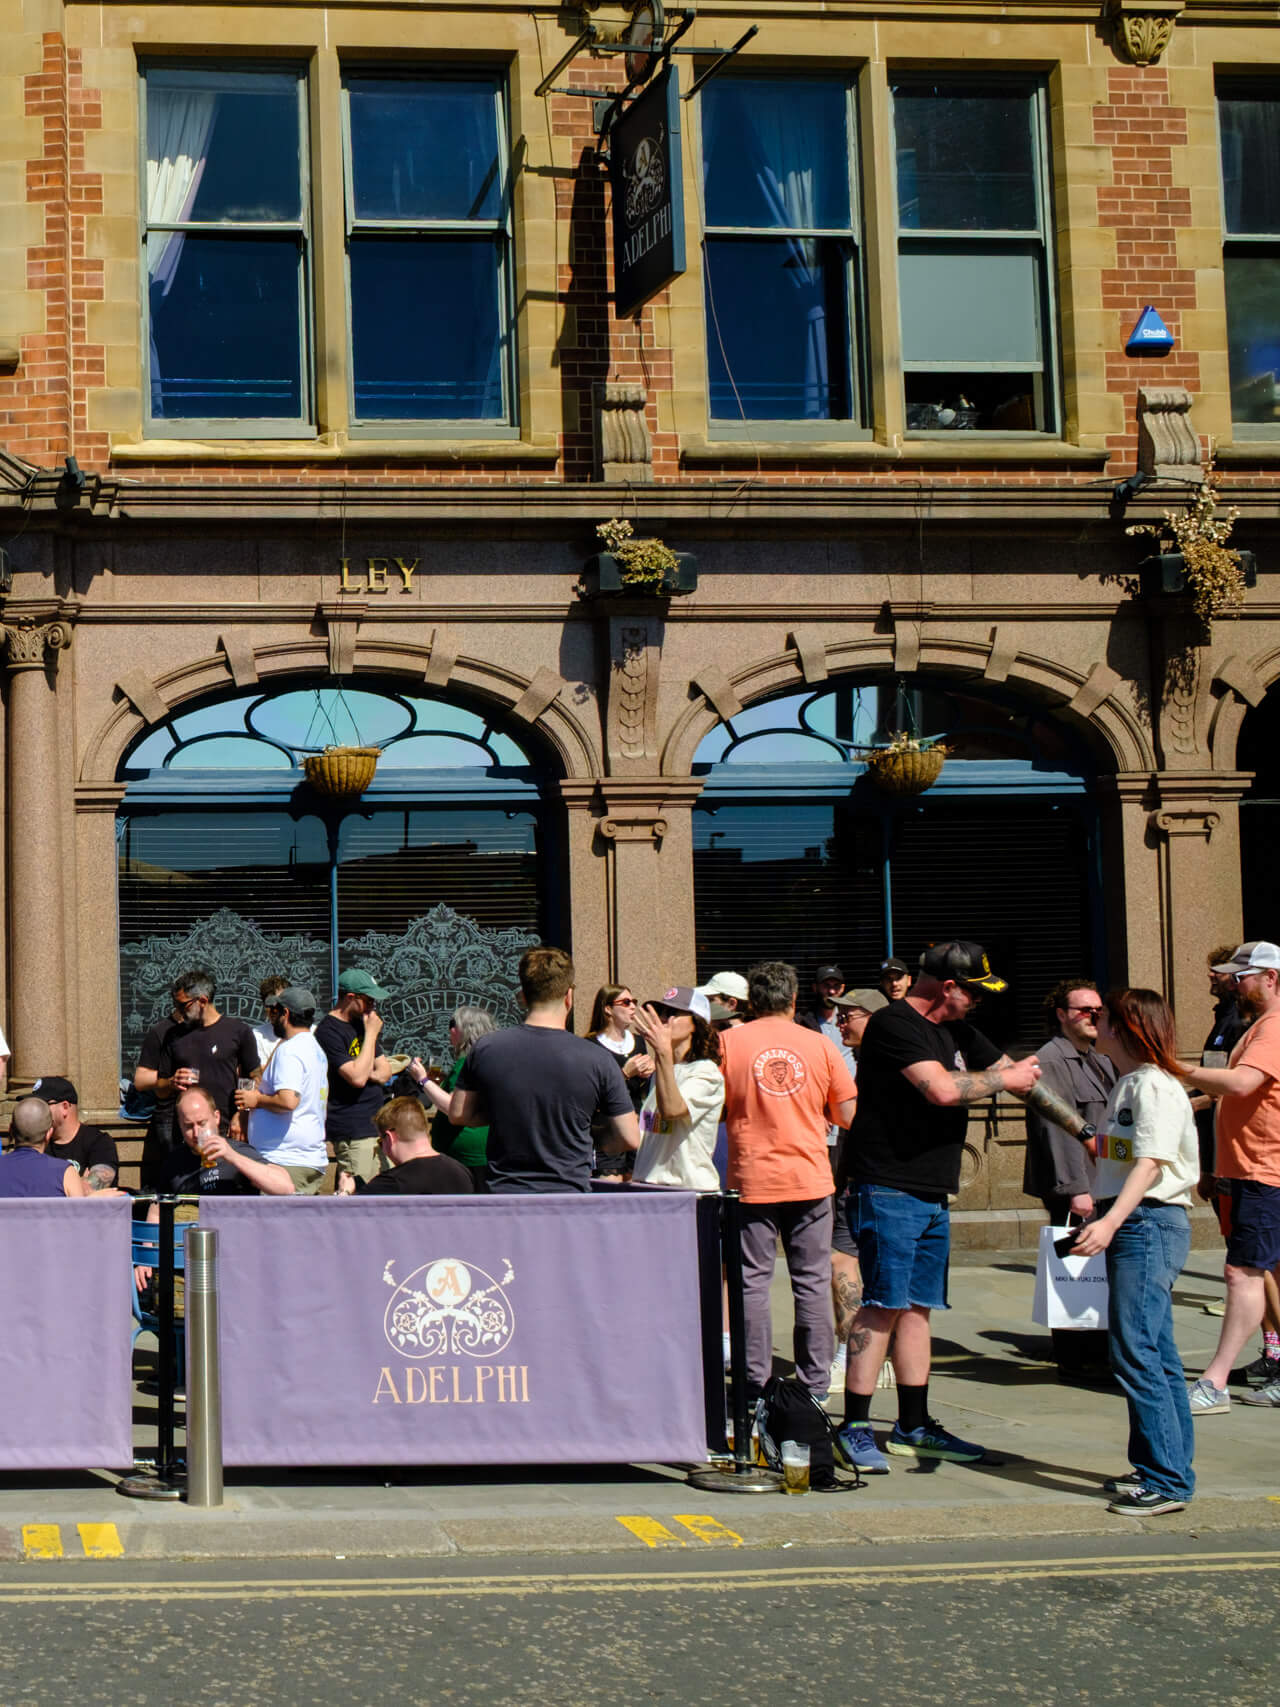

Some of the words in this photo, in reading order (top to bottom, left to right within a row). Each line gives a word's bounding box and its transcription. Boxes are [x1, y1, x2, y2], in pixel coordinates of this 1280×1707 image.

[622, 202, 672, 273] ADELPHI
[340, 557, 422, 589] LEY
[215, 995, 264, 1020] ELPH
[753, 1048, 805, 1078] LUMINOSA
[431, 1266, 465, 1297] A
[372, 1365, 531, 1404] ADELPHI
